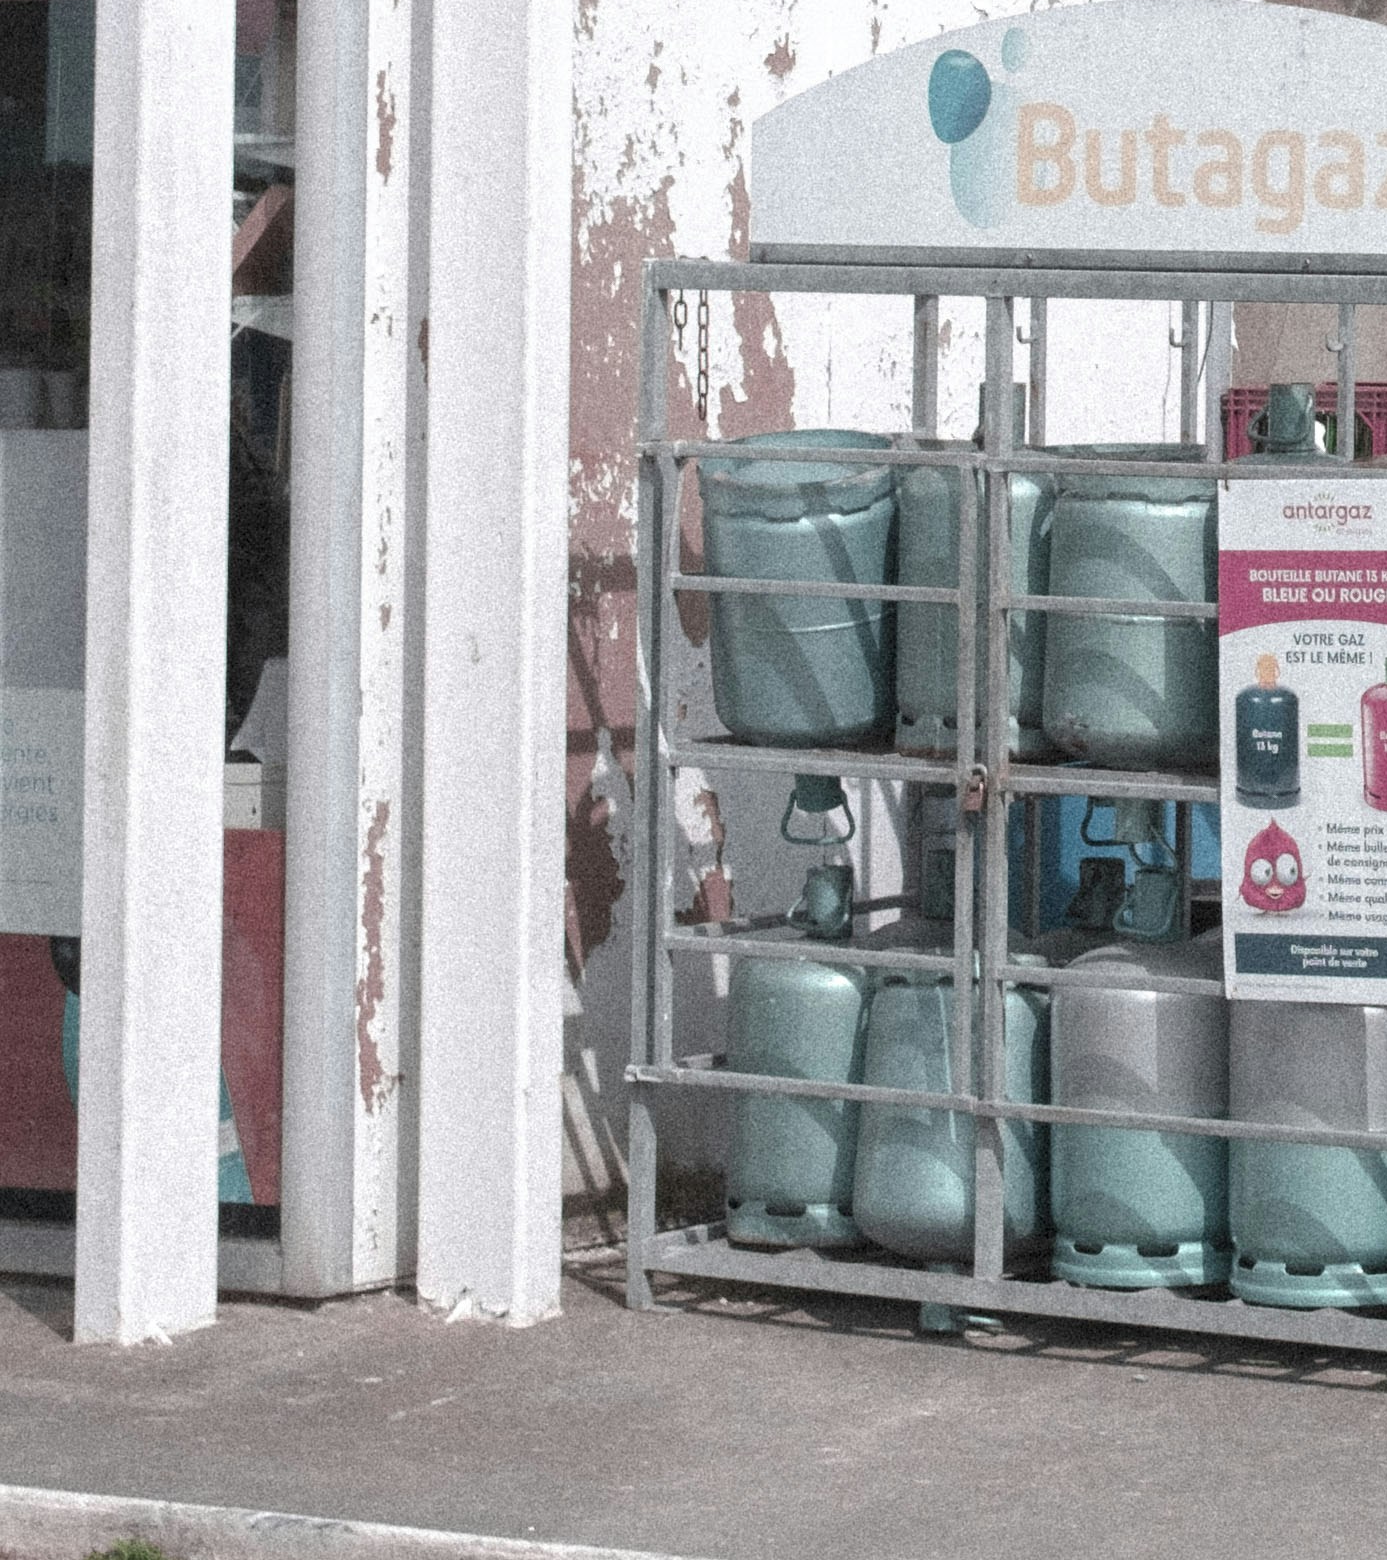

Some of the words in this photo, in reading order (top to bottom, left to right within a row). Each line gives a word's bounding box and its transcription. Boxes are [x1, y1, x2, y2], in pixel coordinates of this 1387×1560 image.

[1282, 501, 1373, 526] antargaz
[1249, 569, 1311, 583] BOUTEILLE
[1315, 569, 1363, 583] BUTANE
[1366, 569, 1378, 583] 15
[1262, 588, 1308, 603] BLEUE
[1312, 588, 1336, 603] OU
[1293, 634, 1334, 646] VOTRE
[1338, 634, 1366, 646] GAZ
[1285, 652, 1307, 664] EST
[1310, 652, 1323, 664] LE
[1327, 650, 1366, 664] MÊME
[1251, 728, 1283, 740] Butane
[1267, 741, 1279, 755] kg
[1326, 823, 1360, 835] Même
[1363, 825, 1384, 838] prix
[1326, 841, 1361, 853] Même
[1327, 855, 1341, 867] de
[1327, 874, 1361, 886] Même
[1328, 892, 1361, 904] Même
[1328, 910, 1362, 922] Même
[1289, 943, 1338, 957] Disponible
[1339, 948, 1353, 957] sur
[1355, 947, 1379, 958] votre
[1302, 957, 1326, 969] point
[1328, 956, 1340, 968] de
[1342, 958, 1368, 969] vente
